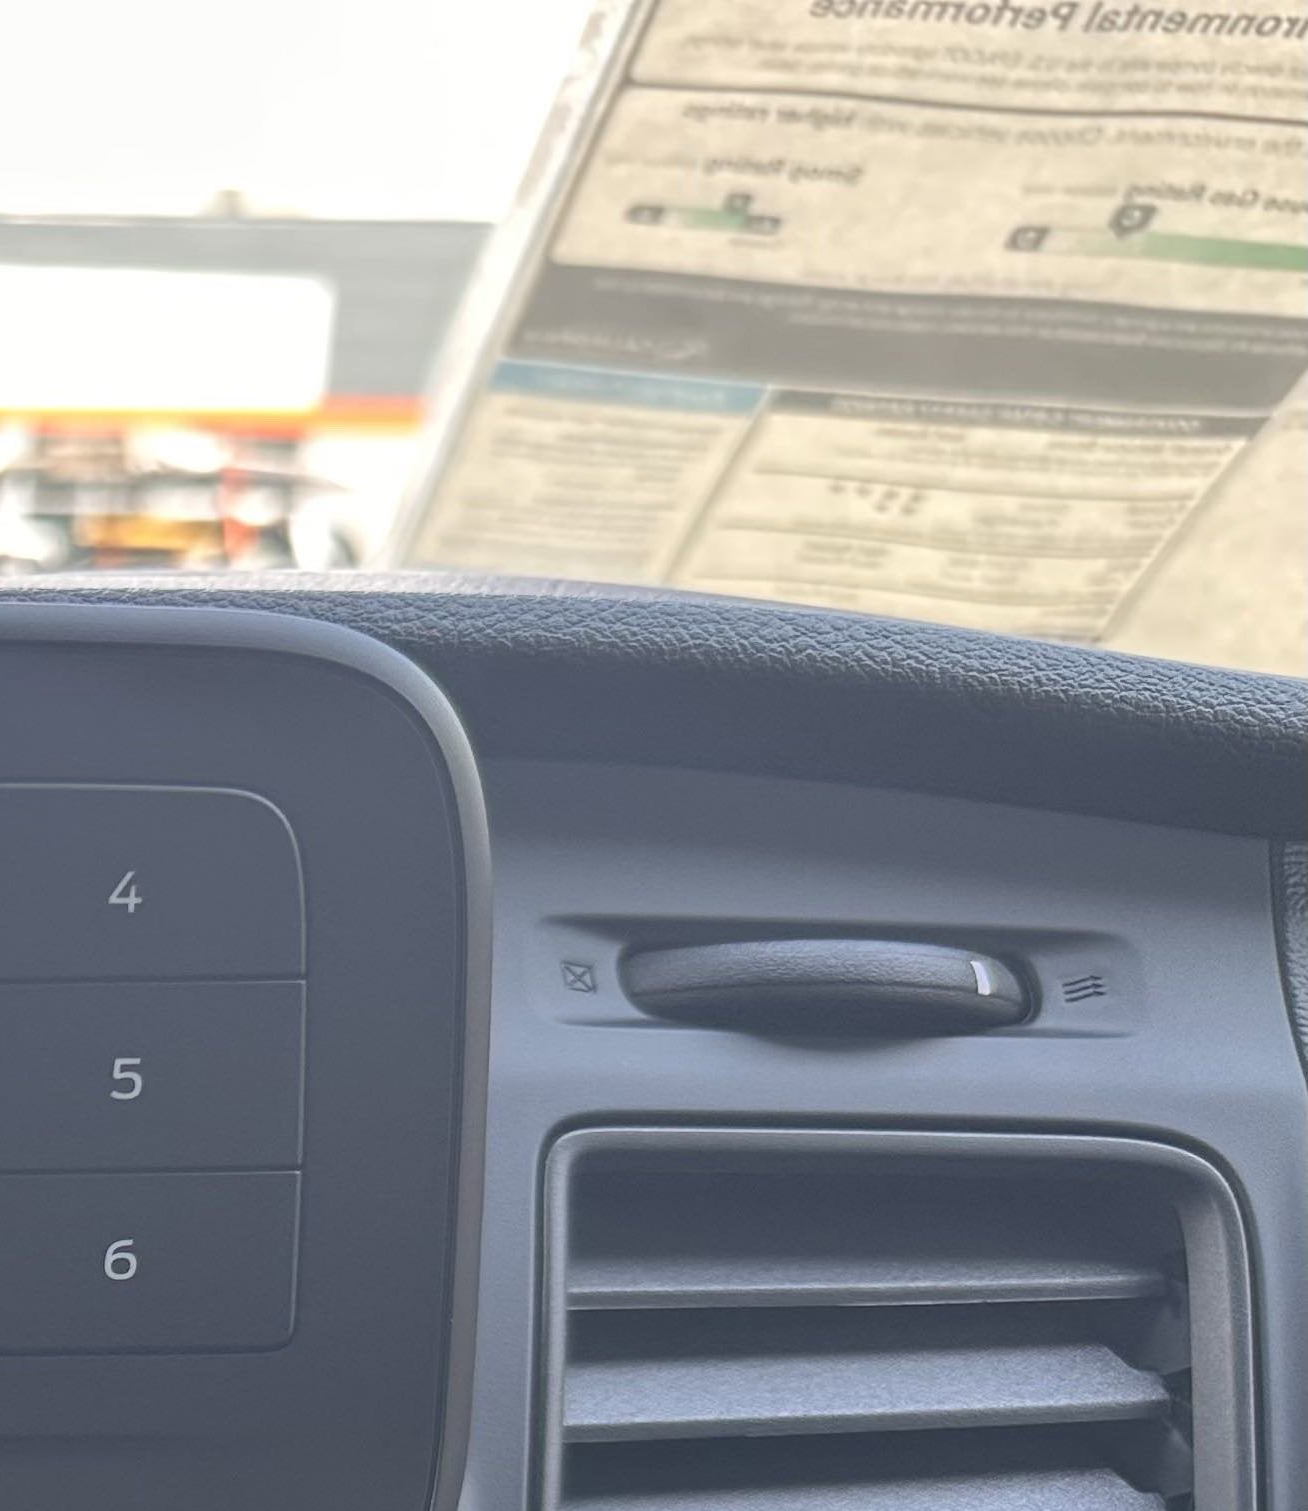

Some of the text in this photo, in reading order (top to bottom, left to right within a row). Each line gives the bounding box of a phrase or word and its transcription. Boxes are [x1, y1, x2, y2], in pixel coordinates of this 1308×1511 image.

[107, 871, 143, 913] 4
[109, 1057, 143, 1100] 5
[102, 1239, 138, 1281] 6
